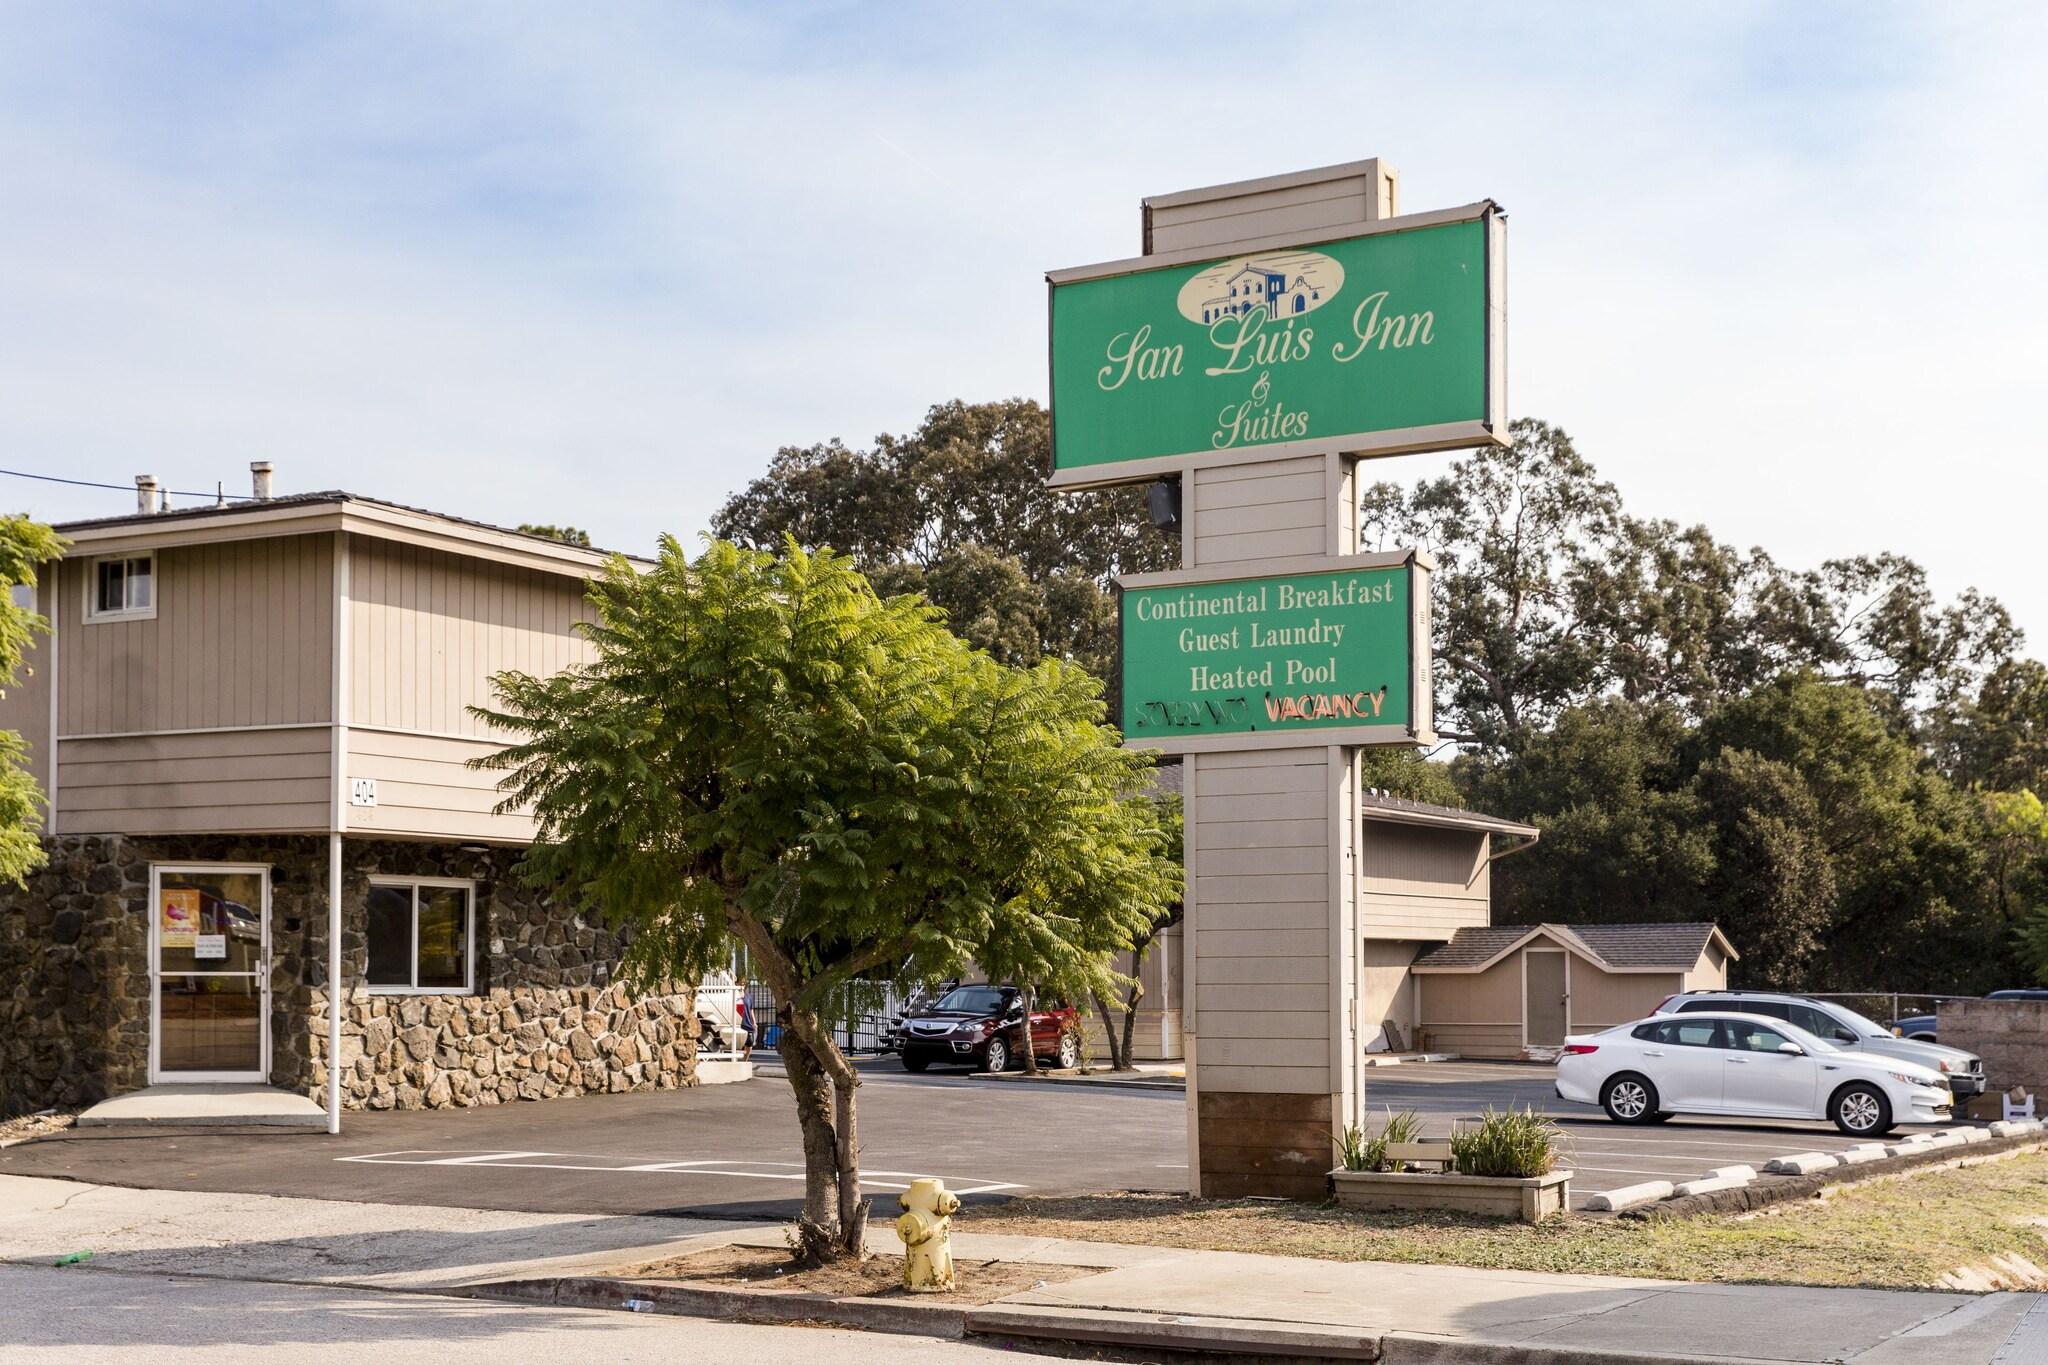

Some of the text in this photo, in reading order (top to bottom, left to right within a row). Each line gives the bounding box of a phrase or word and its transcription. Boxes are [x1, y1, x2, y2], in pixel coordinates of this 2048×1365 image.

[1098, 291, 1434, 391] San Luis Inn
[1251, 370, 1271, 407] &
[1211, 401, 1309, 449] Suites
[1136, 578, 1394, 622] Continental Breakfast
[1179, 618, 1345, 653] Guest Laundry
[1190, 657, 1337, 692] Heated Pool
[1264, 690, 1387, 723] VACANCY
[355, 780, 374, 803] 404
